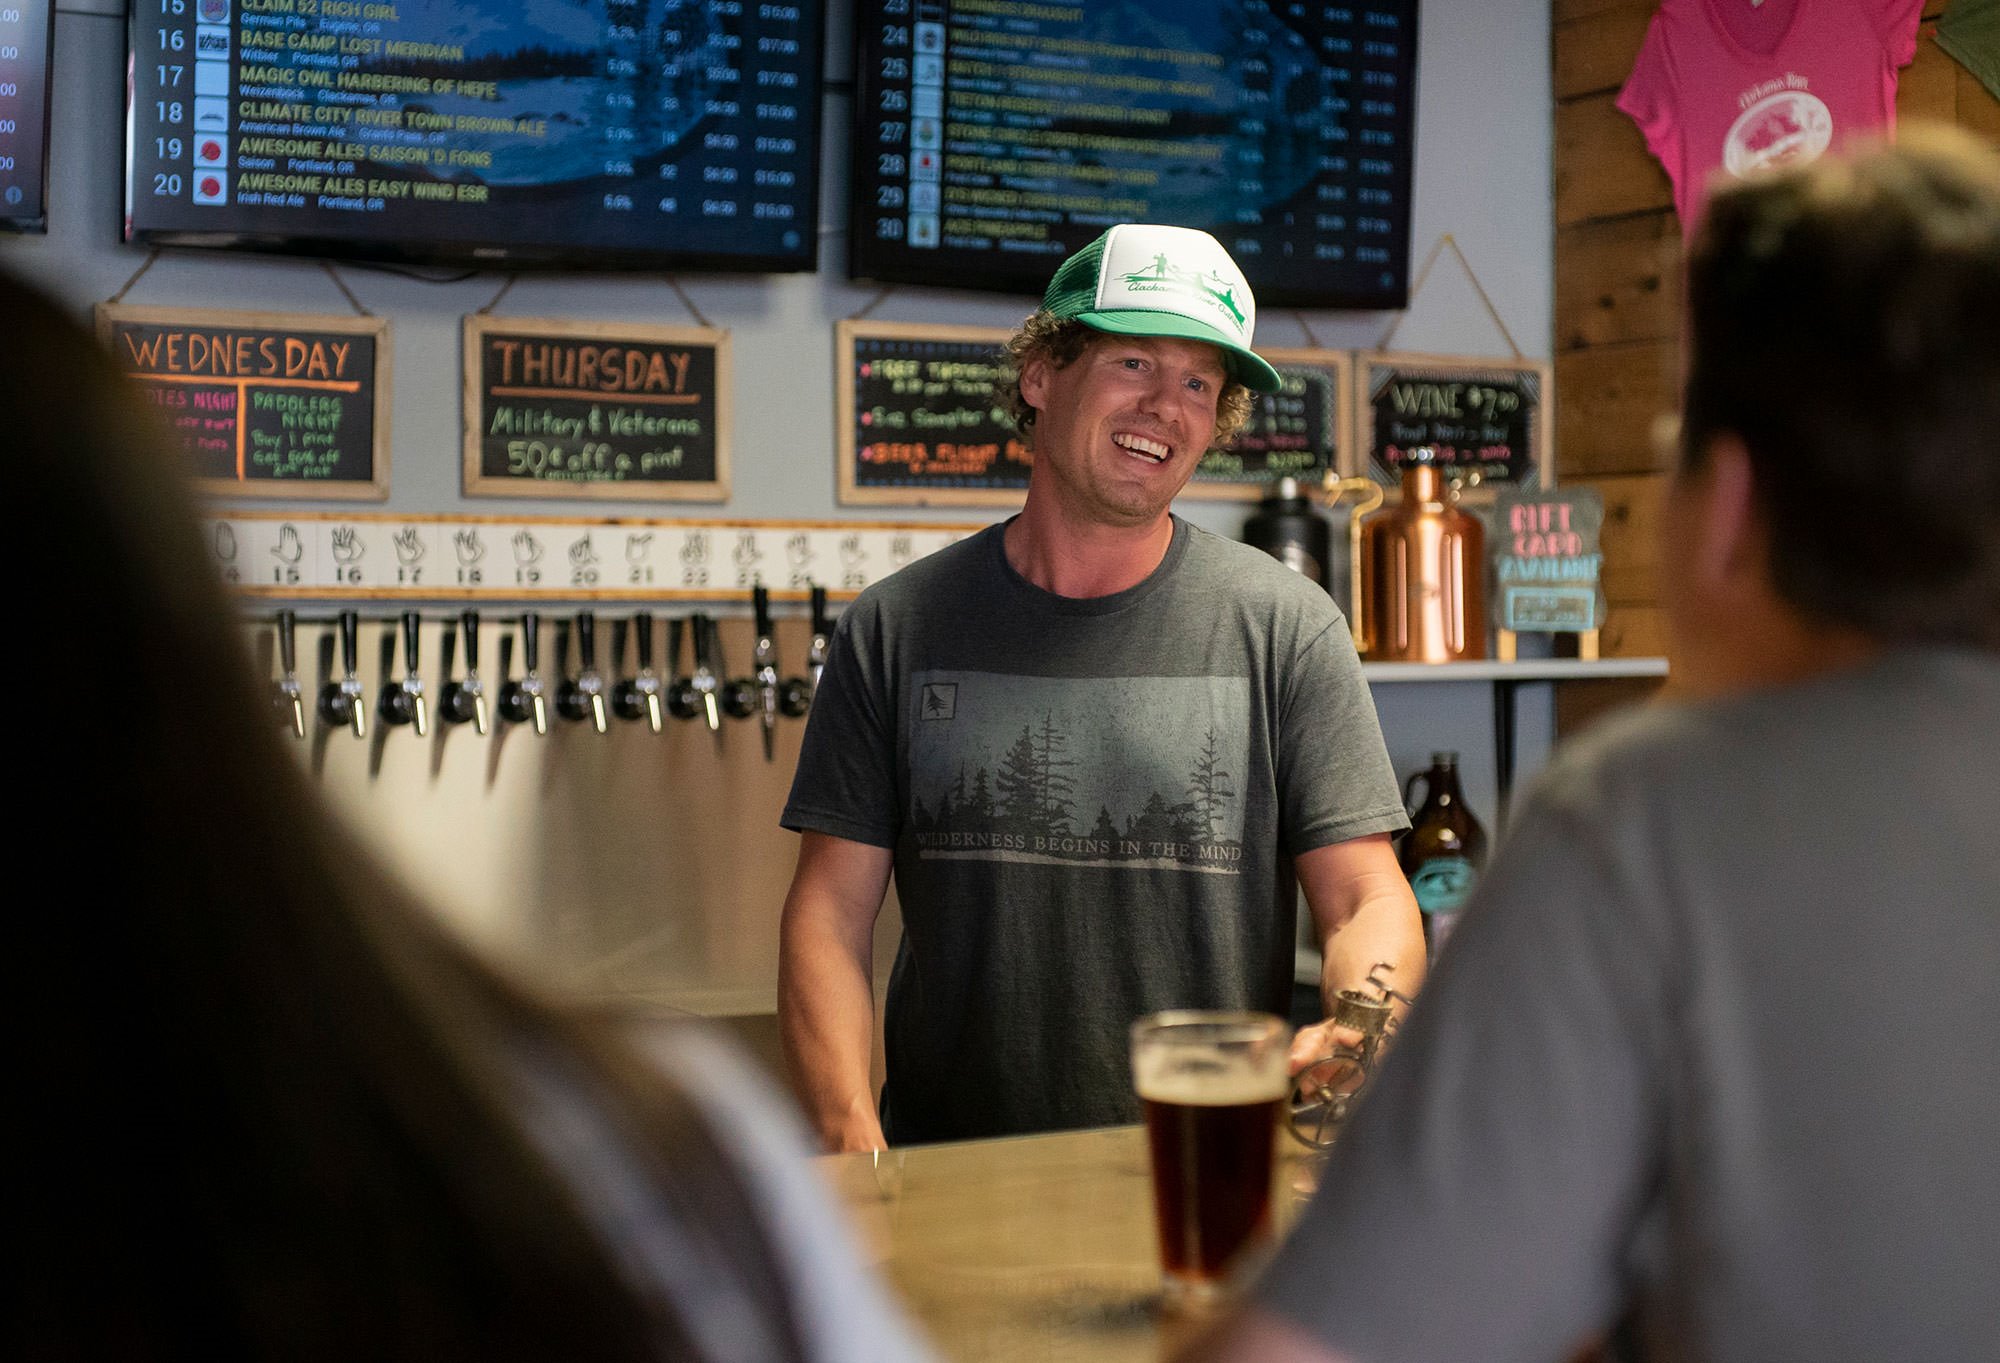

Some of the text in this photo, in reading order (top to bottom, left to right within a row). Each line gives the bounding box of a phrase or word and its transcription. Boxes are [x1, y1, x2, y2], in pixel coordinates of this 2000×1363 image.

[321, 1, 361, 17] RICH
[363, 3, 400, 20] GIRL
[158, 28, 185, 51] 16
[240, 29, 285, 48] BASE
[288, 32, 336, 51] CAMP
[340, 36, 383, 55] LOST
[385, 40, 464, 62] MERIDIAN
[882, 24, 909, 47] 24
[157, 64, 184, 87] 17
[239, 65, 296, 84] MAGIC
[299, 69, 334, 88] OWL
[338, 72, 431, 95] HARBERING
[433, 78, 455, 95] OF
[456, 80, 497, 97] HEFE
[881, 56, 909, 80] 25
[880, 88, 908, 112] 26
[156, 101, 183, 124] 18
[239, 101, 312, 122] CLIMATE
[314, 106, 352, 124] CITY
[355, 108, 403, 126] RIVER
[406, 111, 454, 129] TOWN
[456, 115, 514, 133] BROWN
[516, 119, 546, 138] ALE
[879, 121, 906, 143] 27
[155, 137, 182, 160] 19
[238, 137, 322, 159] AWESOME
[324, 141, 366, 160] ALES
[369, 145, 429, 164] SAISON
[878, 153, 905, 176] 28
[154, 173, 182, 196] 20
[237, 173, 322, 195] AWESOME
[323, 177, 366, 196] ALES
[368, 179, 411, 198] EASY
[413, 182, 455, 200] WIND
[877, 185, 904, 208] 29
[876, 217, 904, 241] 30
[124, 332, 350, 379] WEDNESDAY
[492, 341, 691, 393] THURSDAY
[1392, 382, 1463, 419] WINE
[282, 412, 342, 431] NIGHT
[490, 406, 587, 441] Military
[608, 406, 701, 437] Veterans
[251, 429, 283, 449] Buy
[567, 442, 613, 472] off
[640, 445, 684, 474] pint
[274, 566, 300, 585] 15
[336, 567, 362, 585] 16
[397, 567, 423, 585] 17
[457, 567, 481, 585] 18
[516, 567, 541, 585] 19
[629, 567, 654, 585] 21
[917, 831, 1242, 862] WILDERNESS BEGINS IN THE MIND
